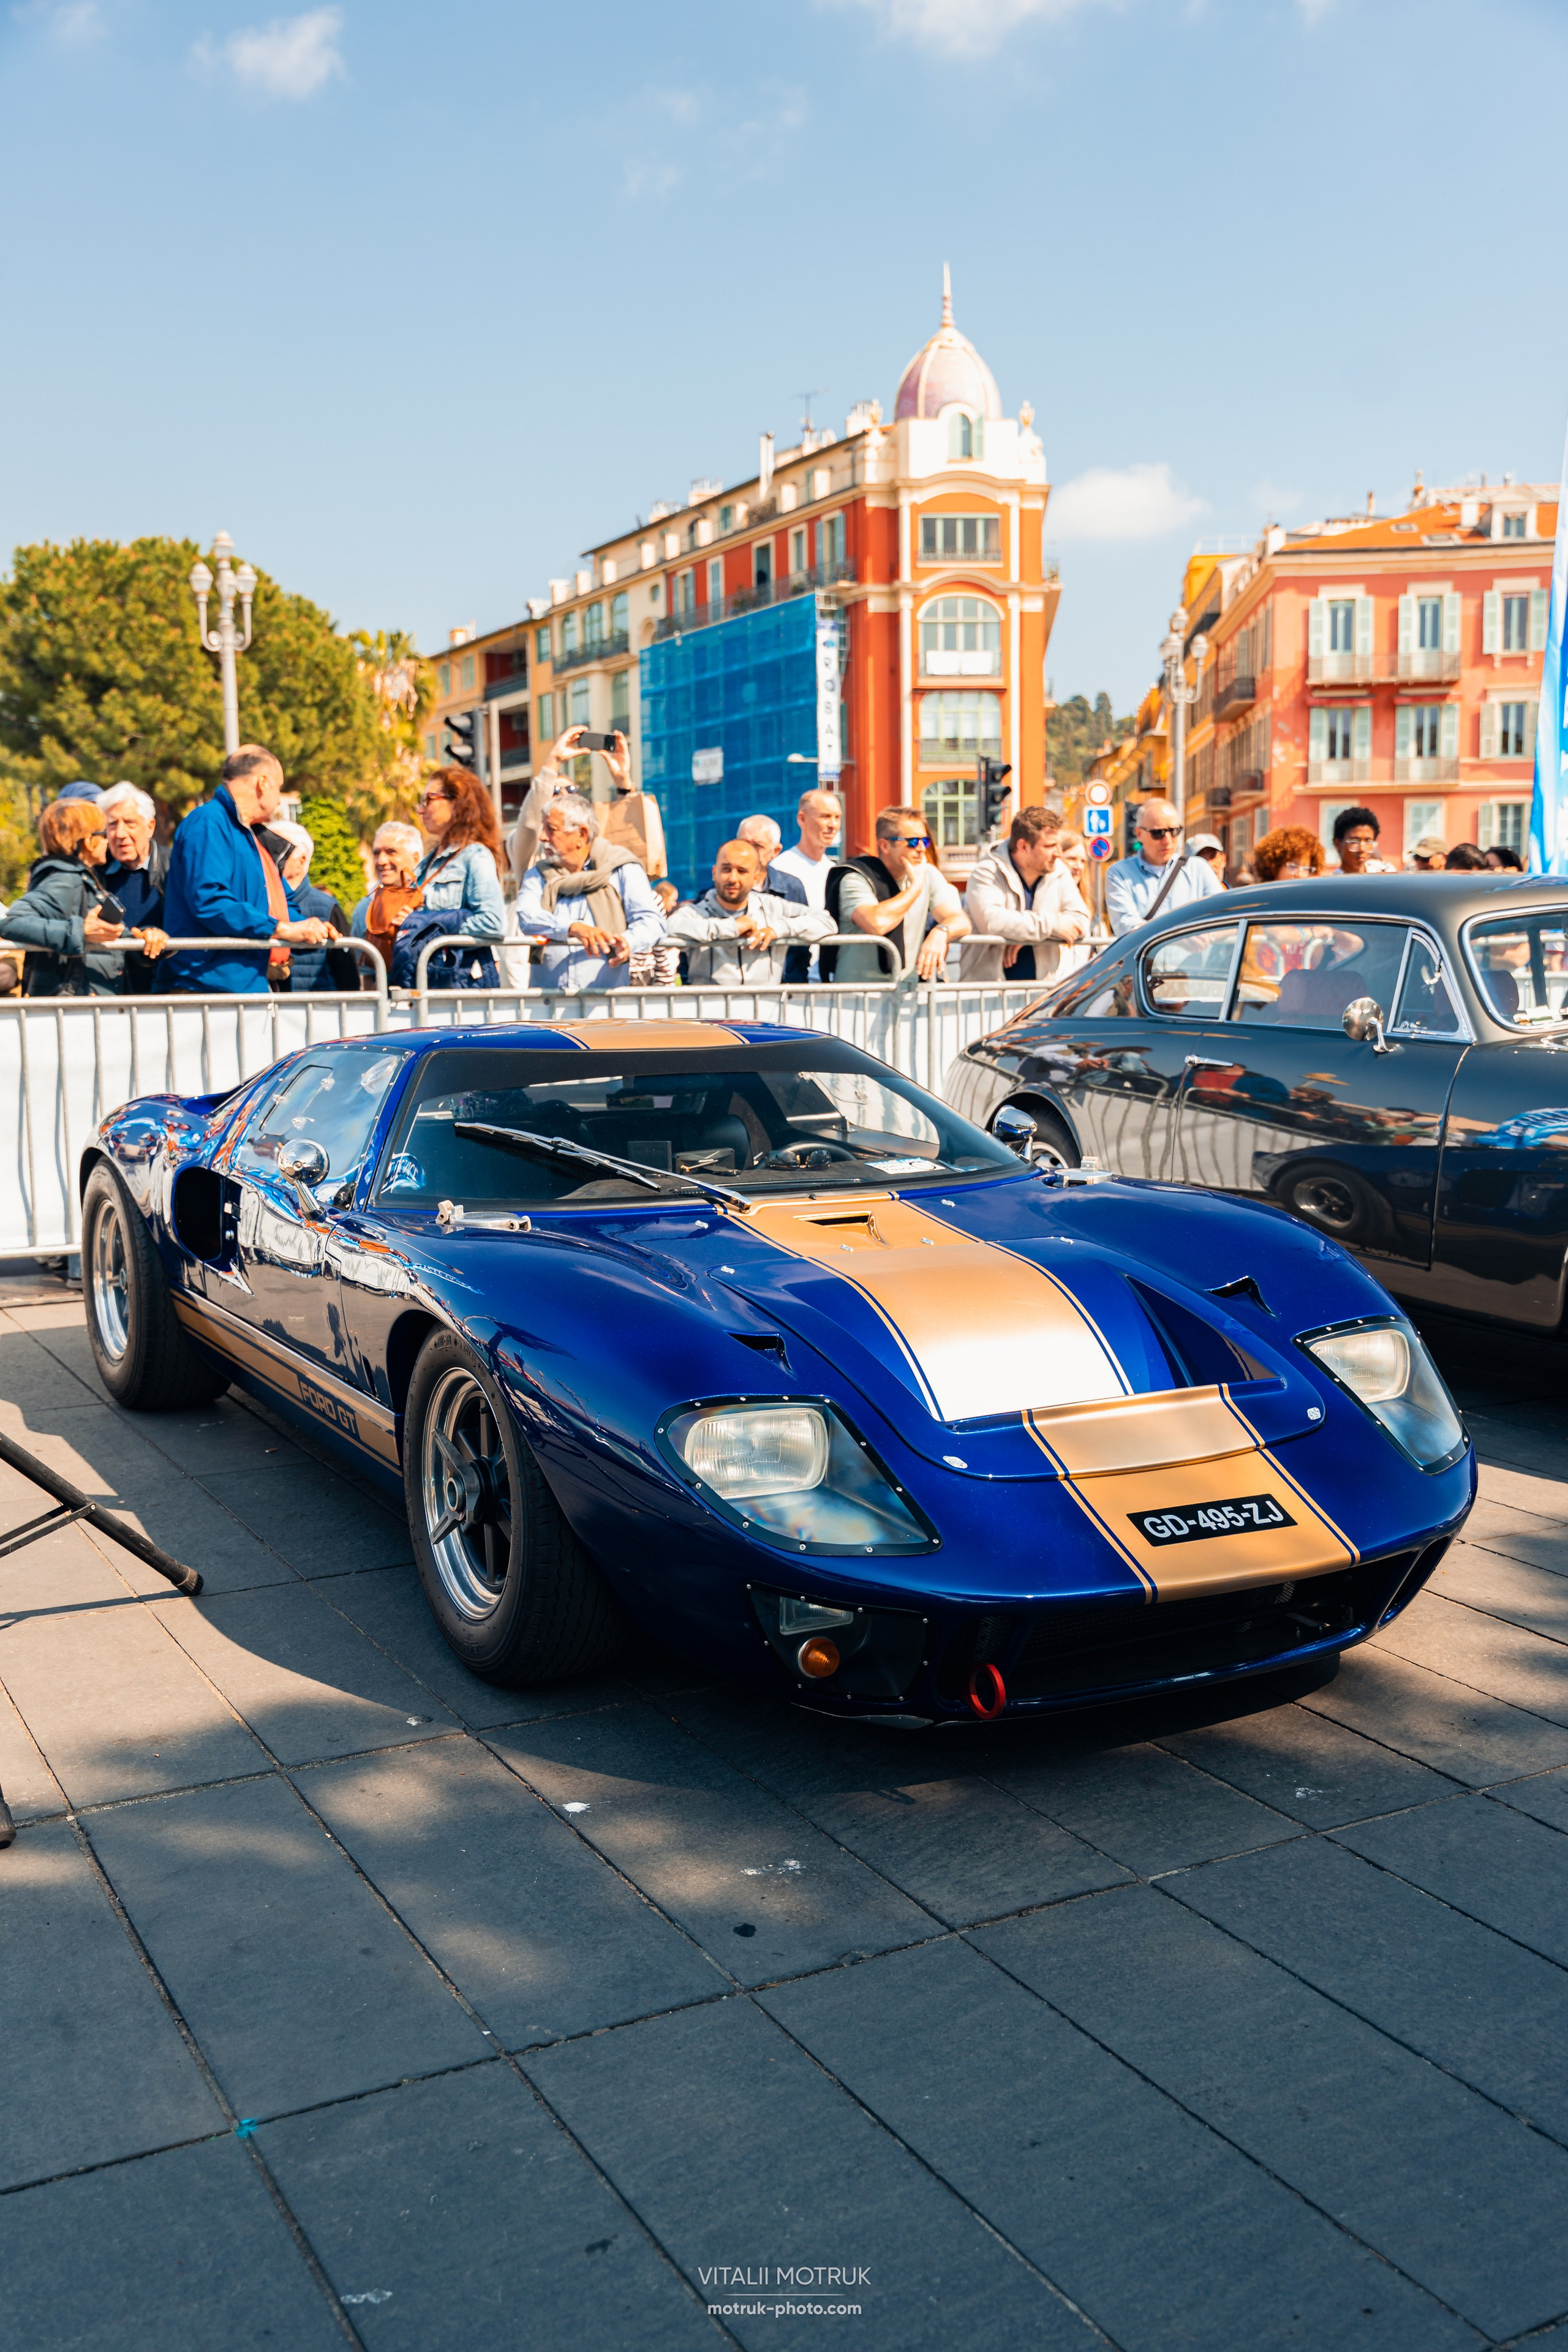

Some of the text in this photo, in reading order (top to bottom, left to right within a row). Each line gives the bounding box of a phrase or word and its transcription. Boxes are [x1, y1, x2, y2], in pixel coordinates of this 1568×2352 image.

[301, 1382, 356, 1434] FORD GT
[1144, 1501, 1284, 1538] GD-495-ZJ
